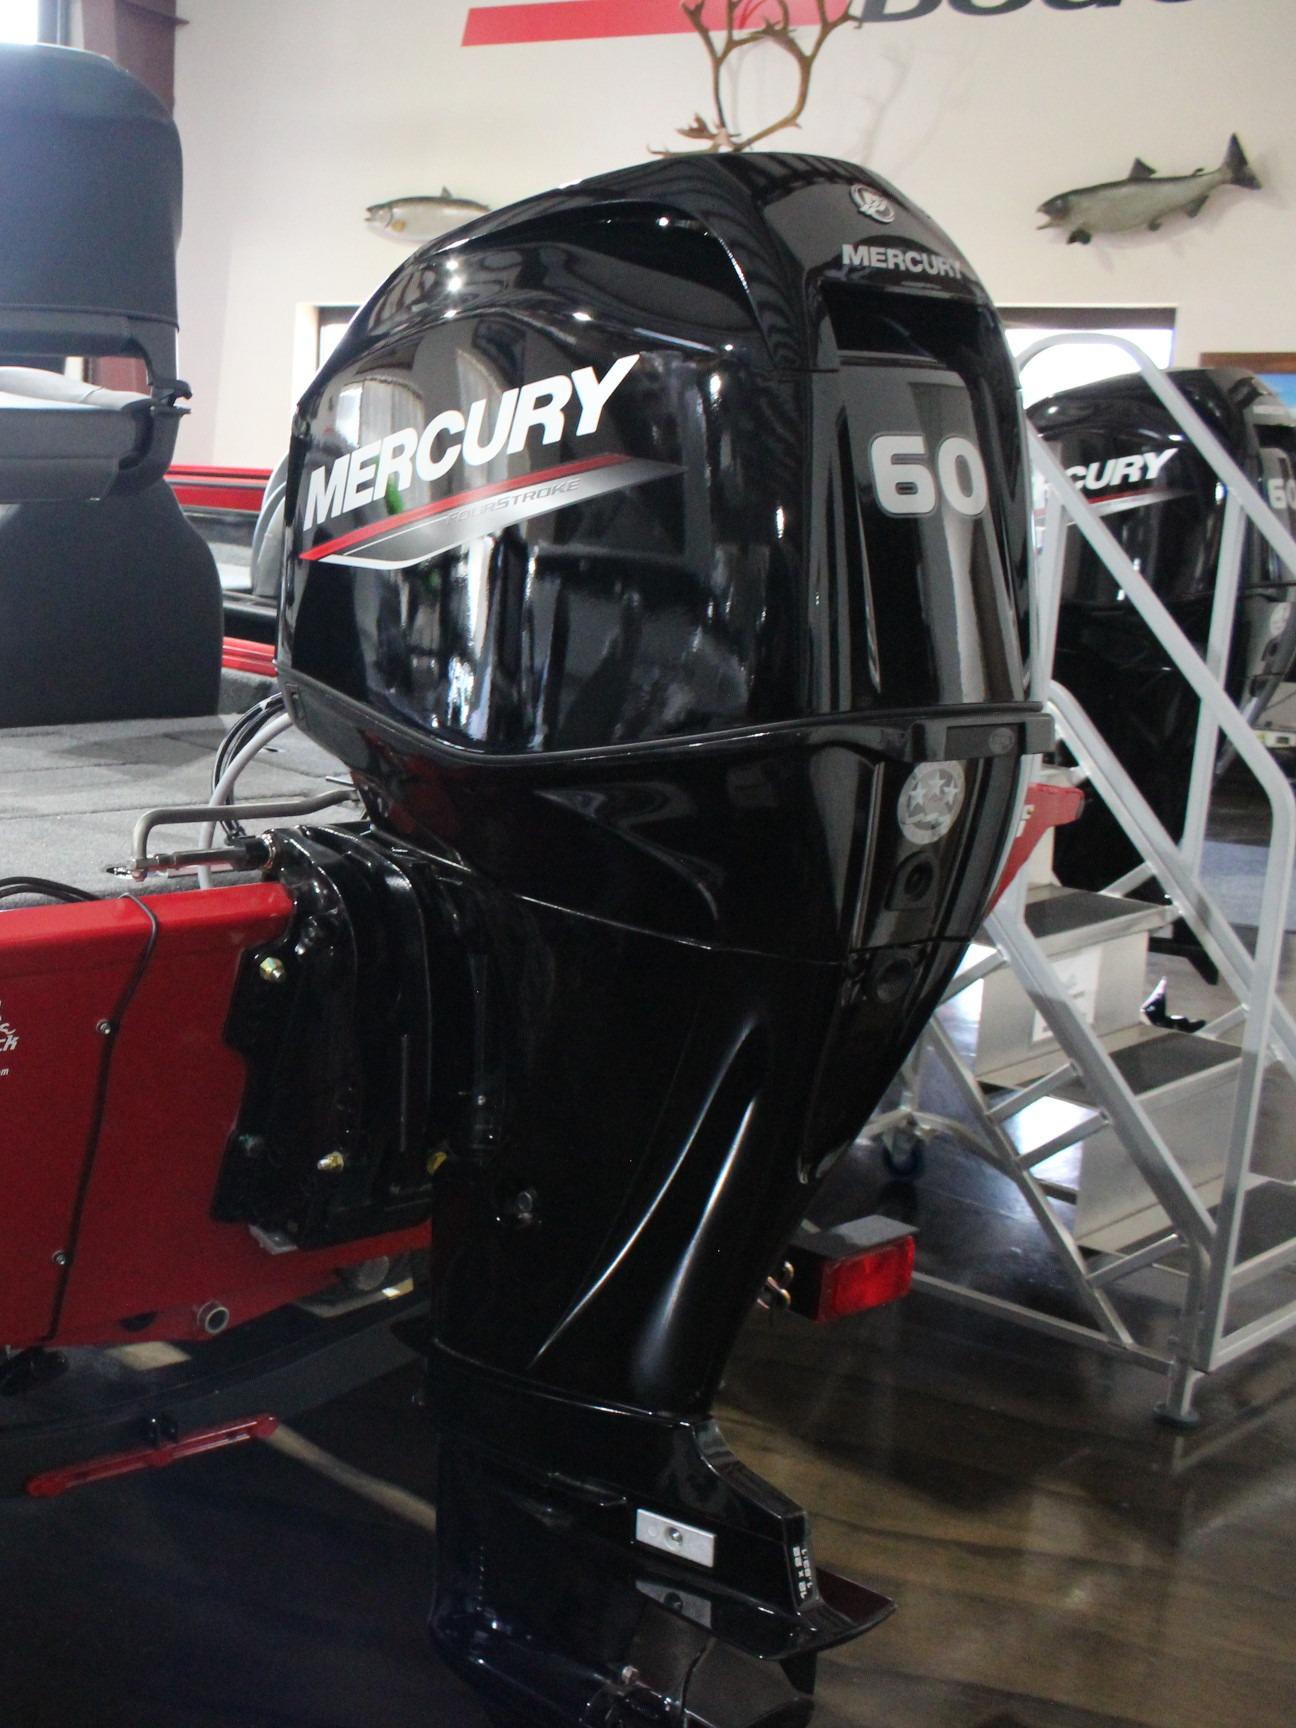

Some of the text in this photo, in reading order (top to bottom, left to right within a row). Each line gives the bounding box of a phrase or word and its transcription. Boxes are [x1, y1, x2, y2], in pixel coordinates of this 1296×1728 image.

[842, 243, 962, 279] MERCURY
[304, 353, 640, 532] MERCURY
[870, 434, 988, 516] 60
